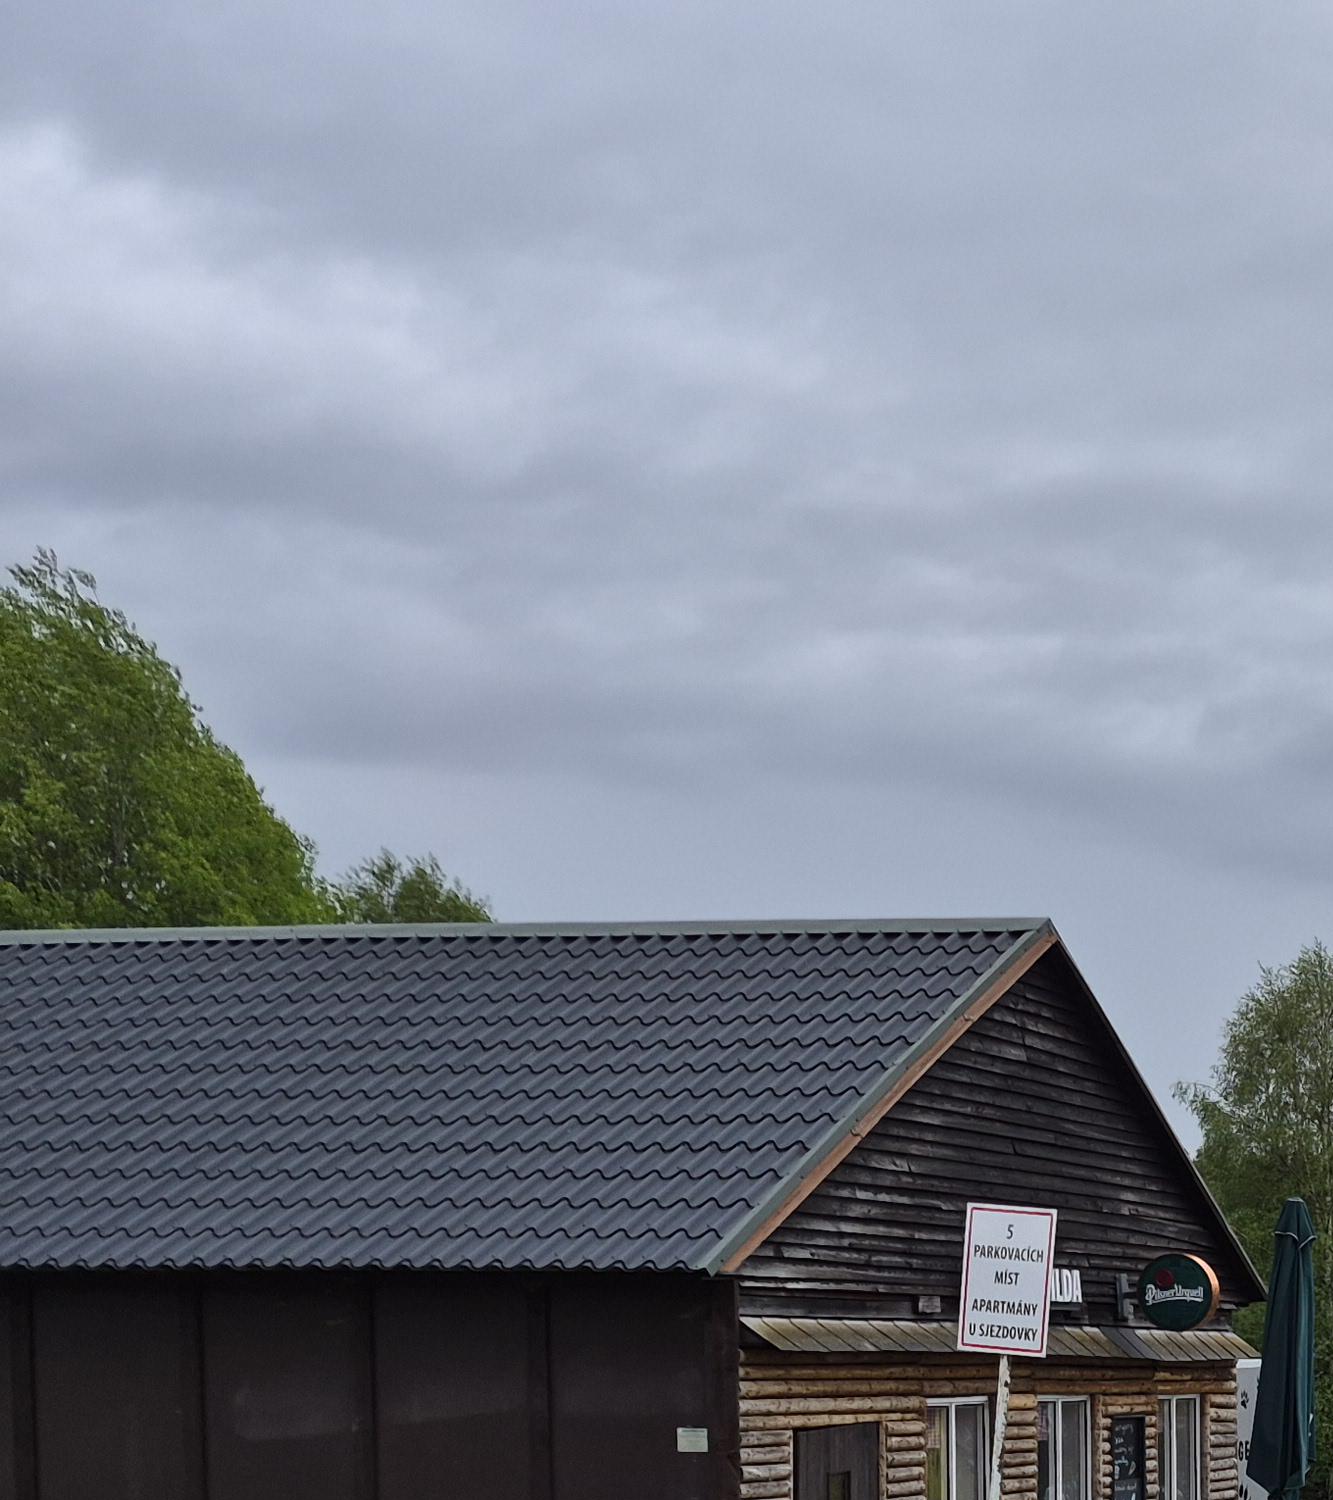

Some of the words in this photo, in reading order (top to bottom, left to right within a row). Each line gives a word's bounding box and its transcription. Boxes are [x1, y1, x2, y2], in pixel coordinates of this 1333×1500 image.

[1006, 1224, 1014, 1239] 5
[973, 1244, 1044, 1263] PARKOVACÍCH
[994, 1269, 1020, 1285] MÍST
[1145, 1284, 1175, 1305] Pilsner
[1174, 1283, 1203, 1302] Urquell
[971, 1298, 1038, 1316] APARTMÁNY
[969, 1323, 976, 1336] U
[978, 1323, 1038, 1342] SJEZDOVKY
